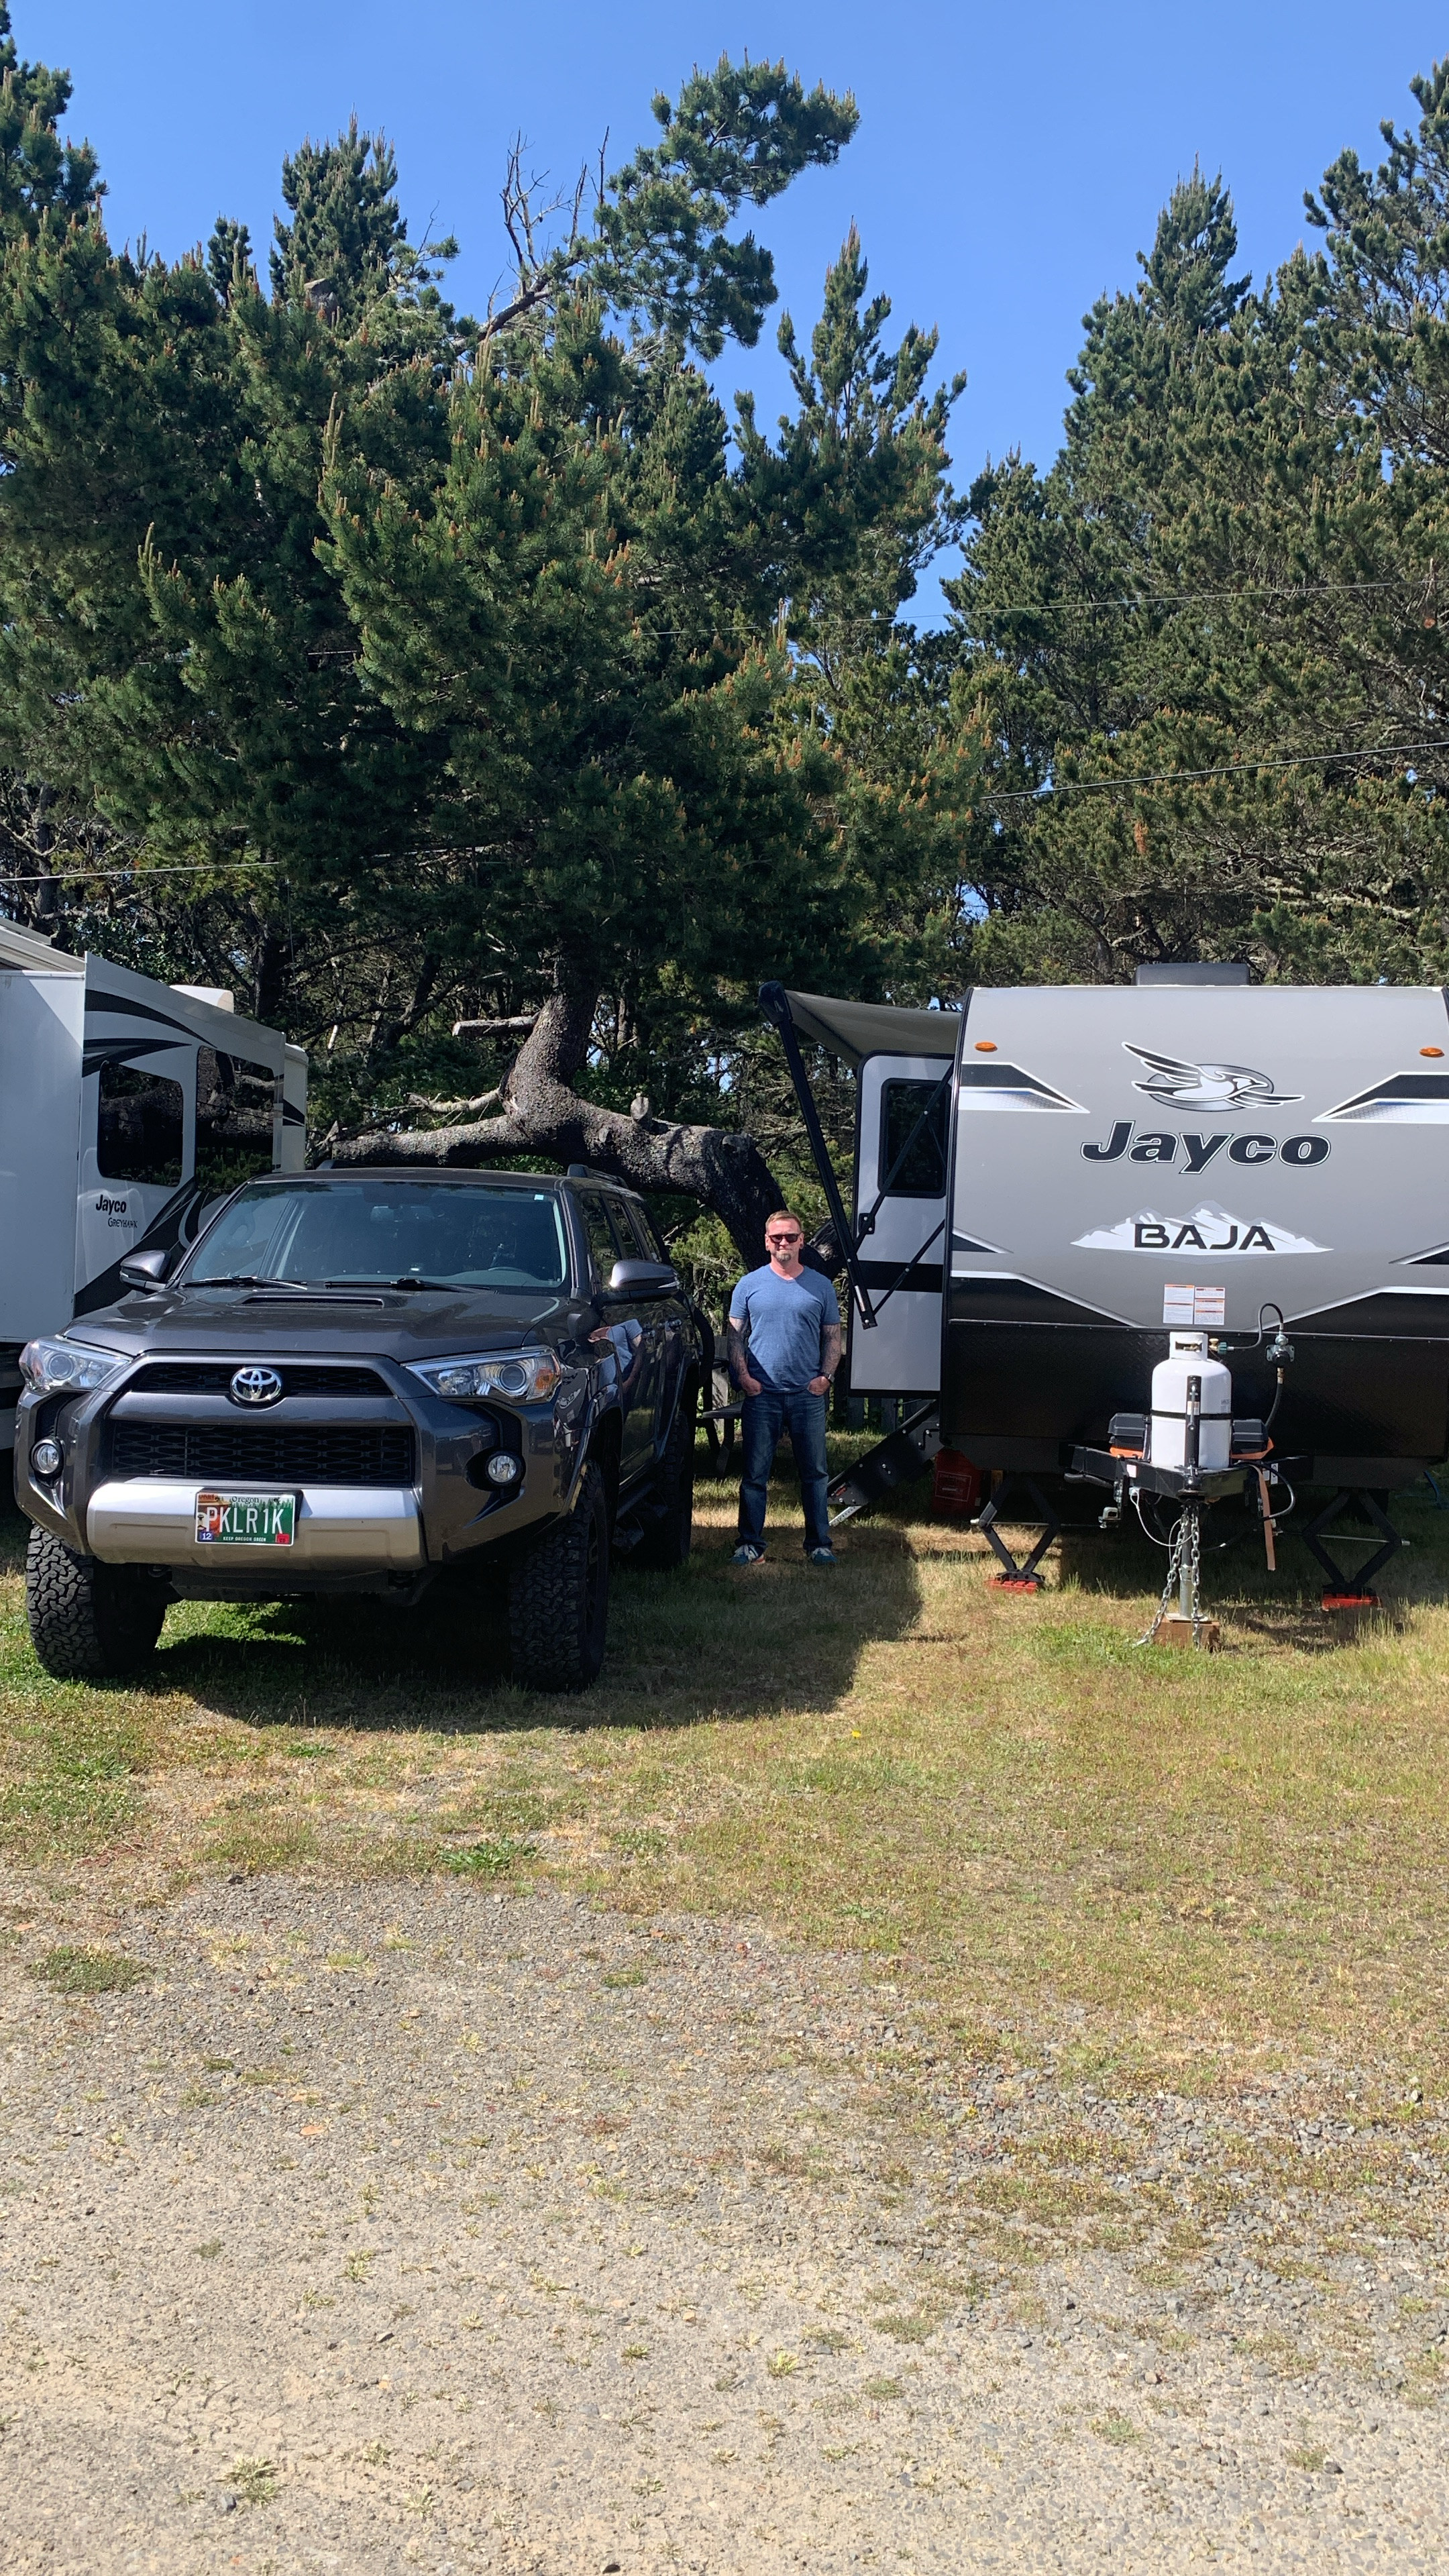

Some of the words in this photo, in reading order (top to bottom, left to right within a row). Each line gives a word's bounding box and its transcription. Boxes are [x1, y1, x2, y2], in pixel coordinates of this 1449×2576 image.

[1081, 1120, 1331, 1175] Jayco
[96, 1194, 127, 1216] Jayco
[1134, 1224, 1275, 1251] BAJA
[231, 1496, 259, 1505] Oregon
[207, 1507, 284, 1534] PKLR1K
[202, 1532, 211, 1540] 12
